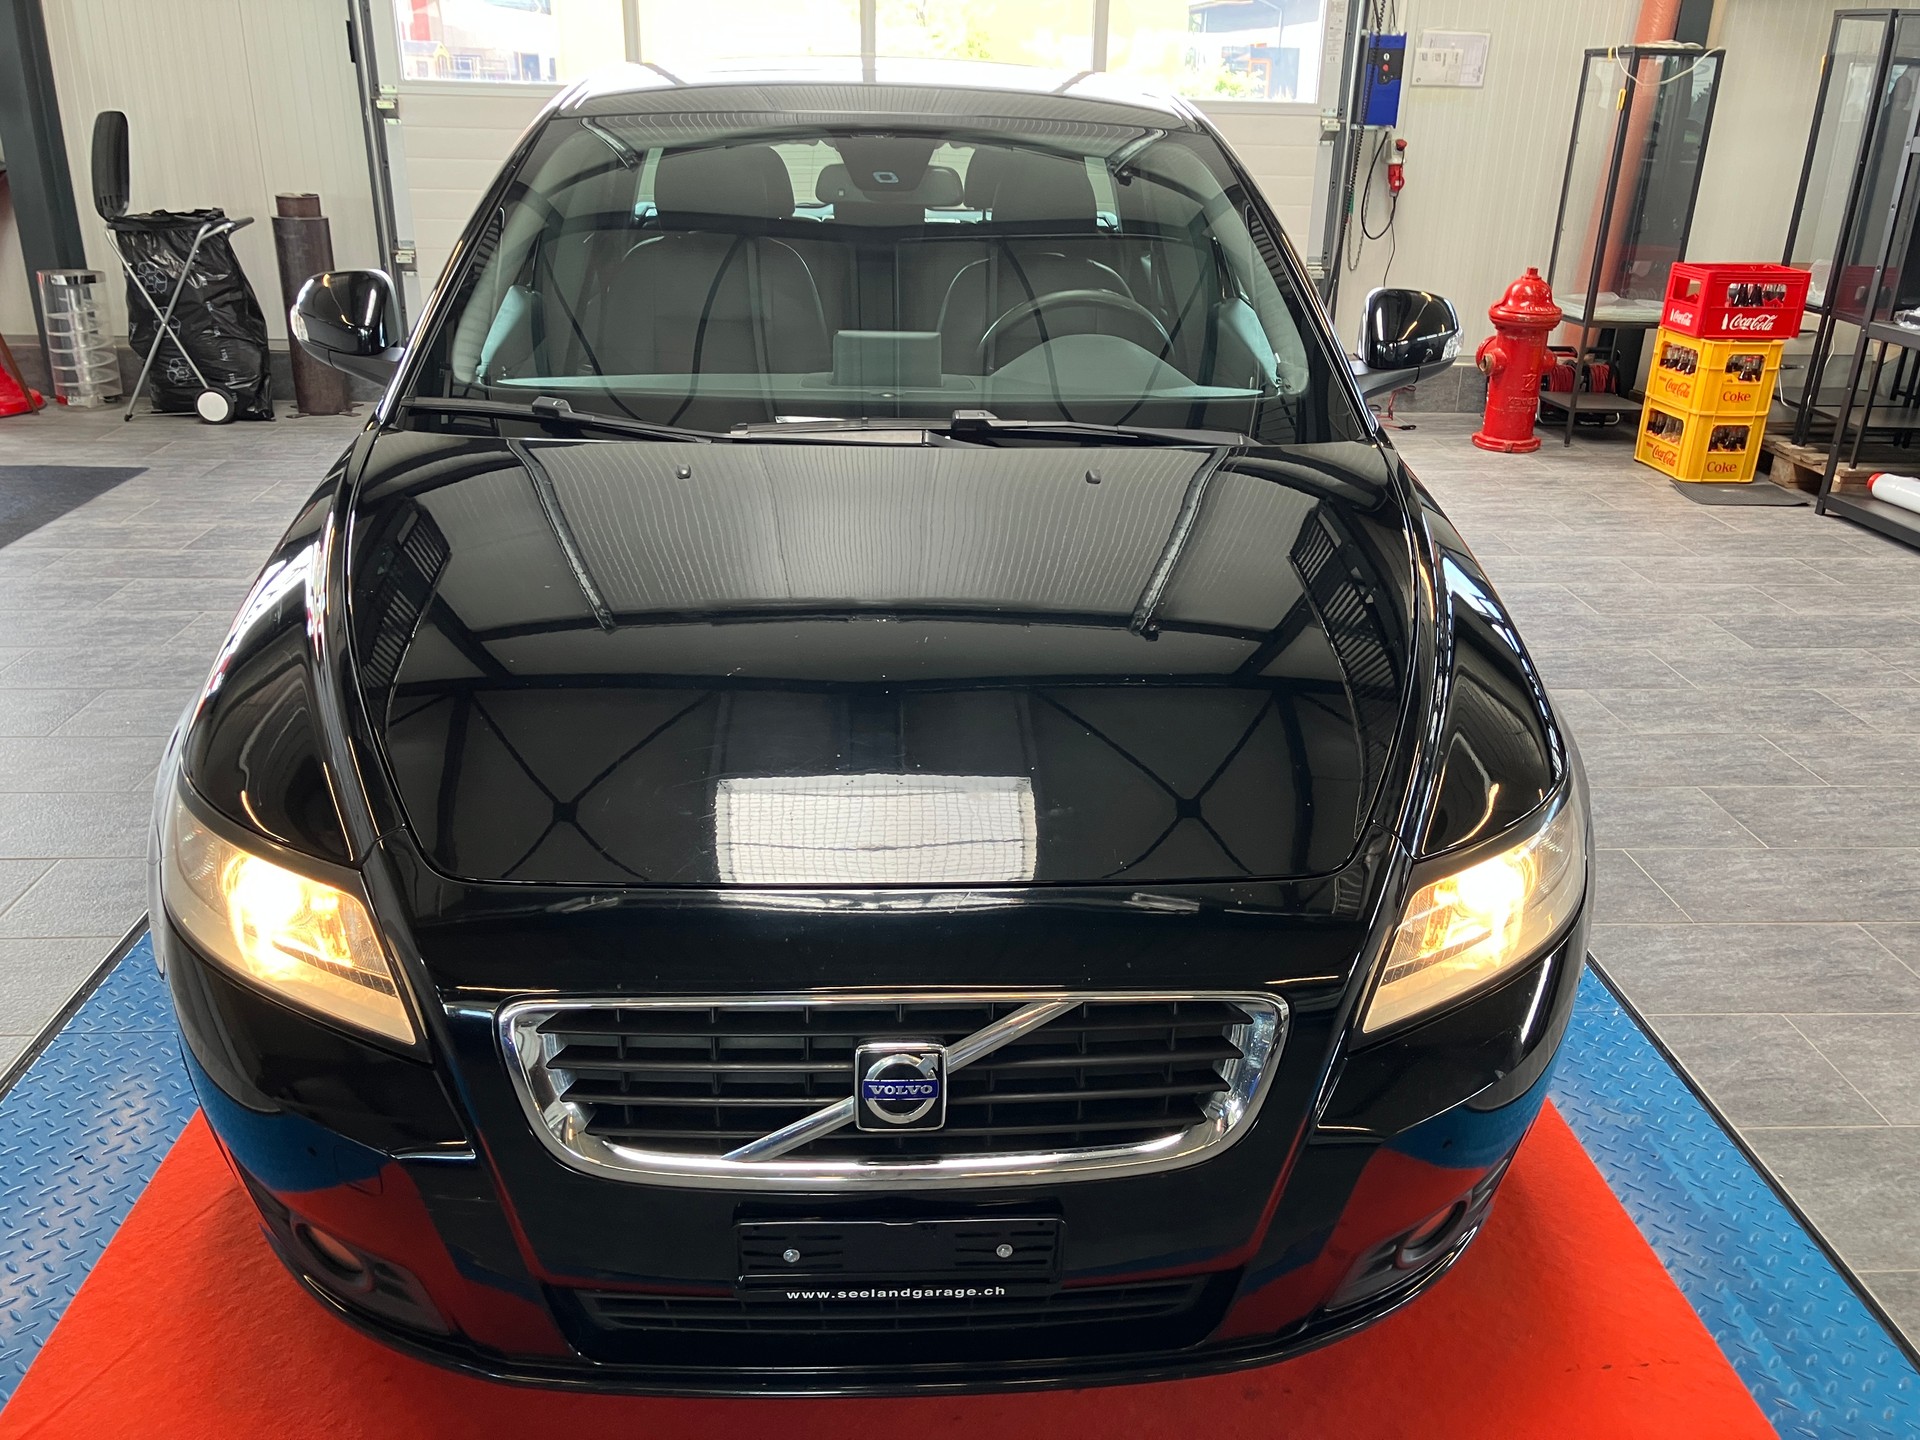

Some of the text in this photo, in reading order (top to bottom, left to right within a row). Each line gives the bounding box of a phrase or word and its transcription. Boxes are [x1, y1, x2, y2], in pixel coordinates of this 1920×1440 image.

[1729, 313, 1778, 331] Coca-Cola
[1723, 391, 1751, 402] Coke
[1707, 461, 1737, 473] Coke
[868, 1084, 933, 1095] VOLVO
[786, 1285, 1006, 1299] www.seelandgarage.ch
